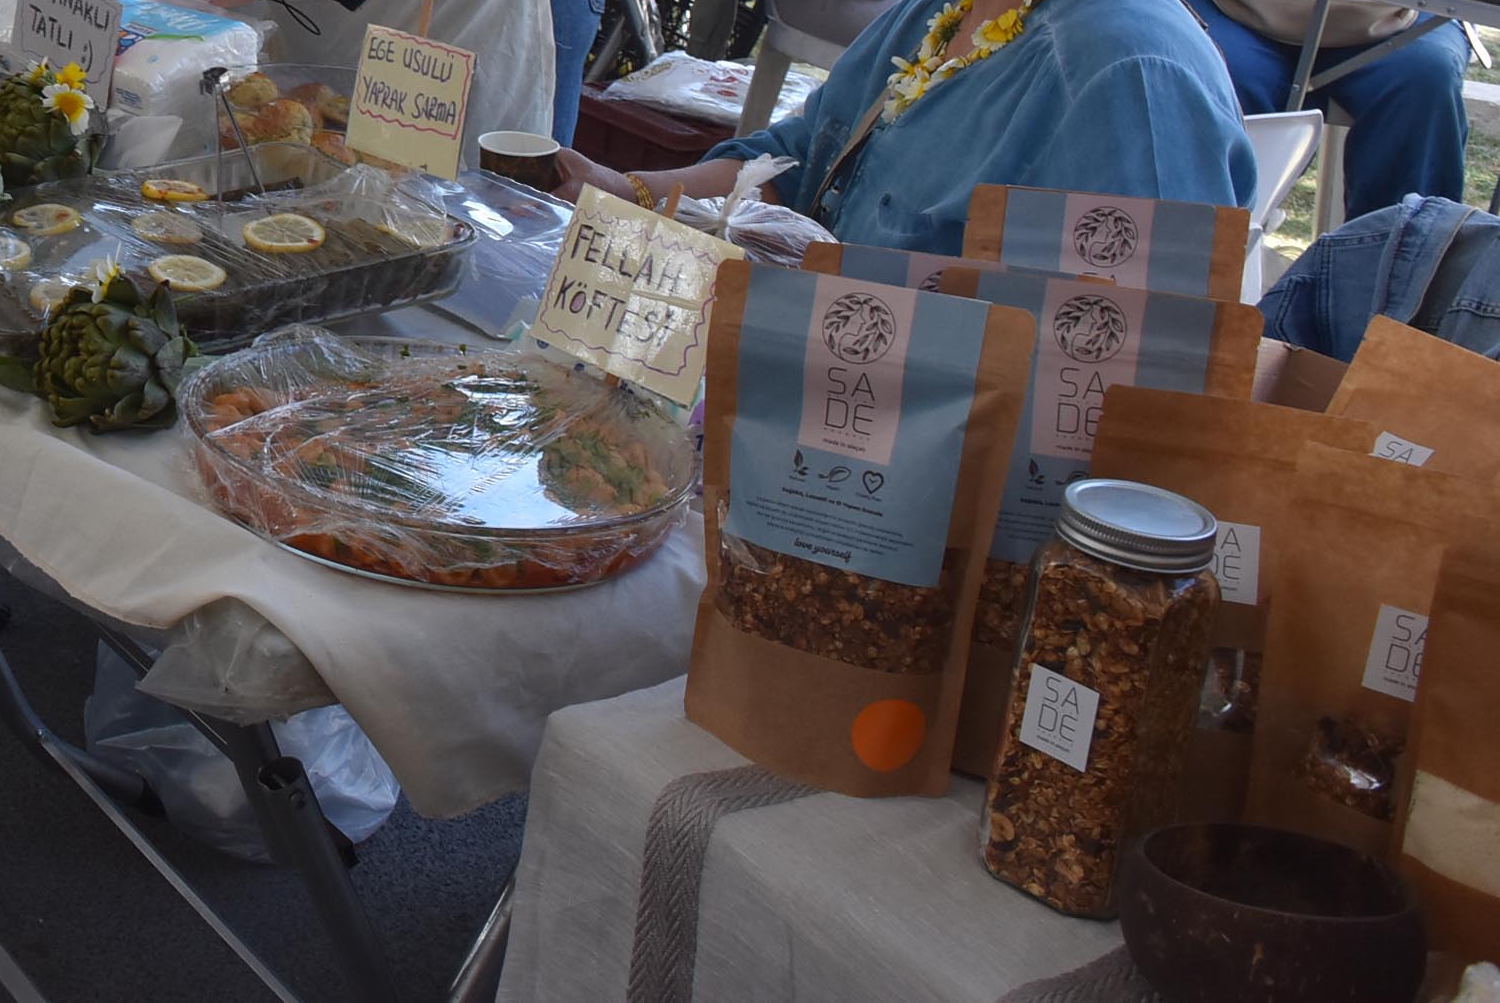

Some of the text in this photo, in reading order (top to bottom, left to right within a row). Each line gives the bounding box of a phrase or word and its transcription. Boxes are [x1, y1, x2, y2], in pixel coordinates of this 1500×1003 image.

[29, 4, 73, 50] TATLI
[367, 36, 455, 83] EGE USULÜ
[363, 75, 408, 116] YAPRAK
[569, 224, 685, 297] FELLAH
[827, 366, 876, 402] SA
[824, 397, 876, 436] DE
[1378, 440, 1414, 464] SA
[793, 538, 853, 563] love yourself
[1043, 676, 1080, 715] SA
[1037, 703, 1078, 743] DE
